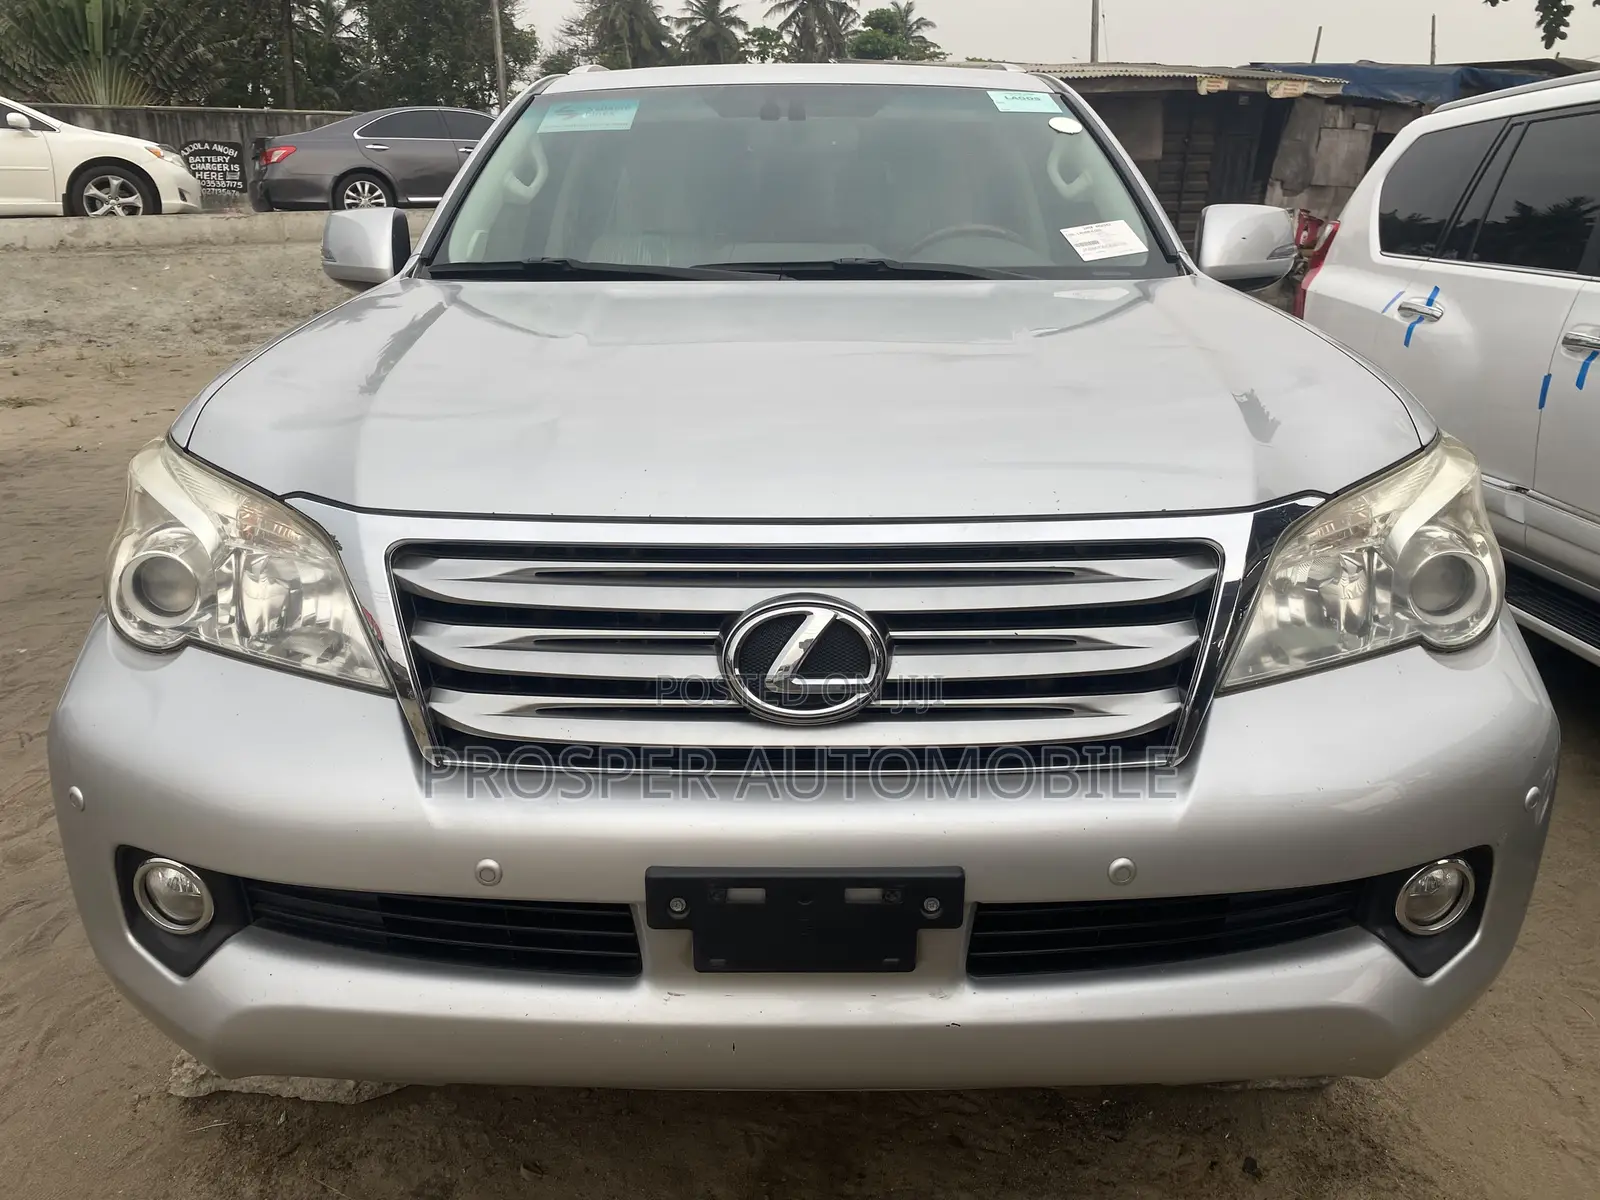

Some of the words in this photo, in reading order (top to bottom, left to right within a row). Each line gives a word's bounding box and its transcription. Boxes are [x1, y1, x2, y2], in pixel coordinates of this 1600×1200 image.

[212, 144, 238, 158] ANOBI
[190, 163, 229, 171] CHARGER
[196, 171, 224, 180] HERE
[200, 180, 243, 188] 035387175
